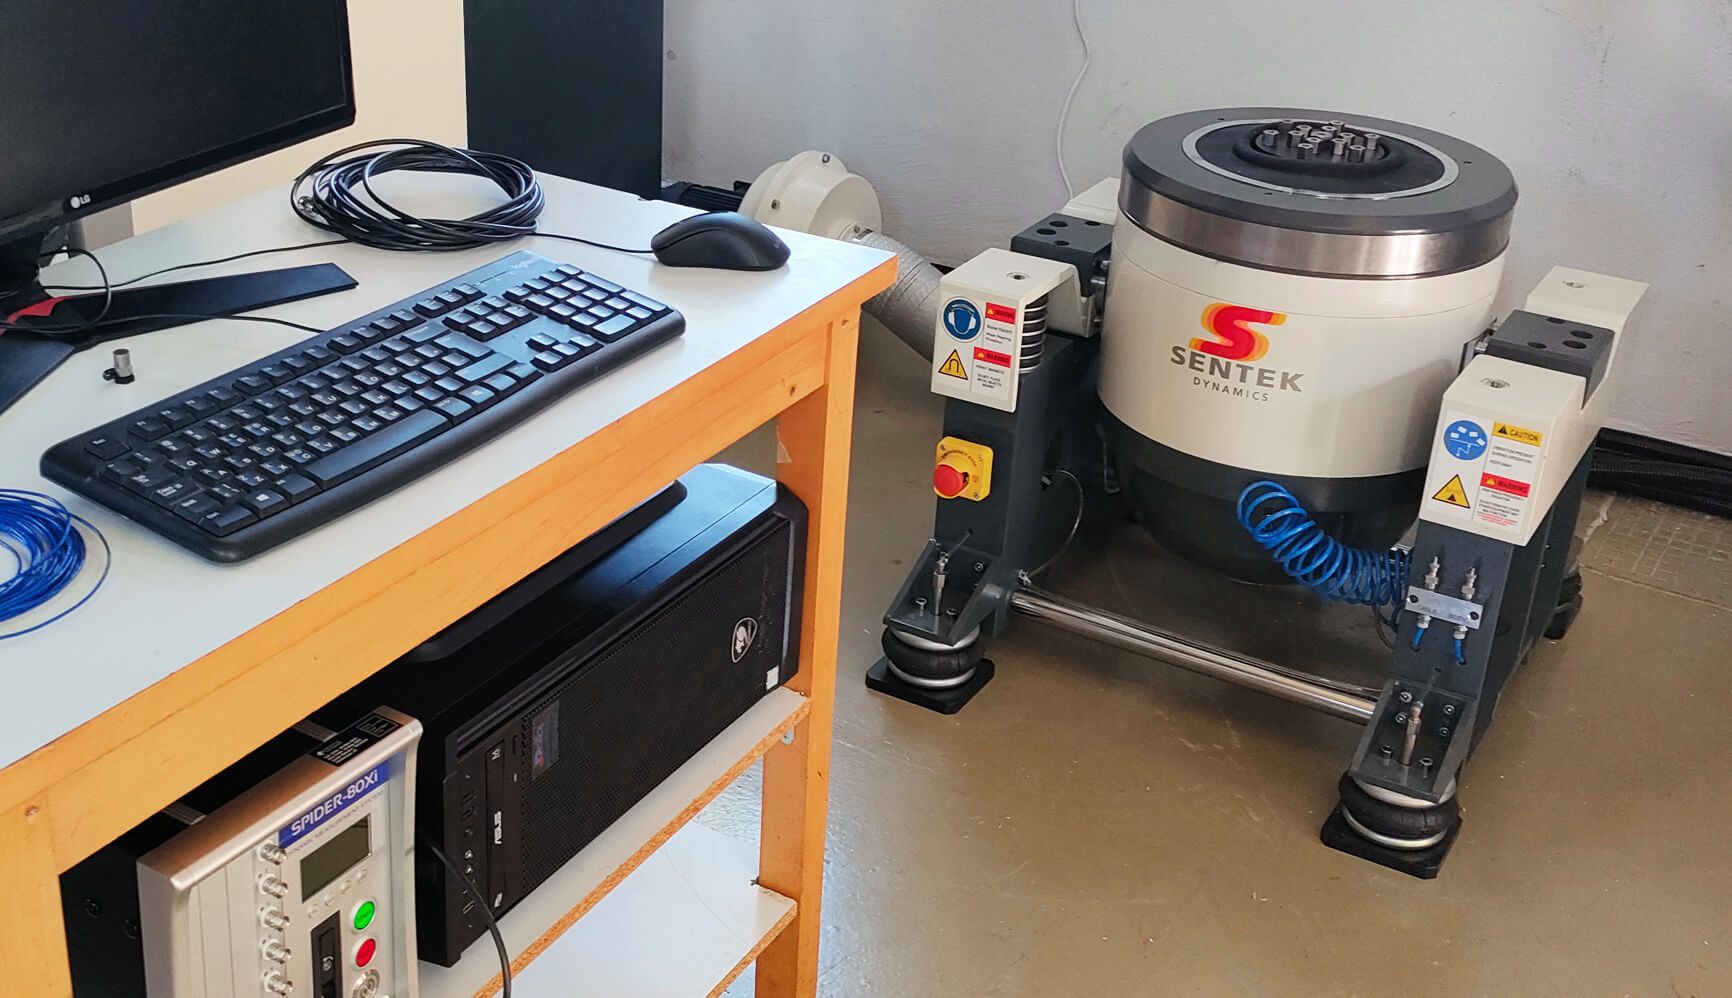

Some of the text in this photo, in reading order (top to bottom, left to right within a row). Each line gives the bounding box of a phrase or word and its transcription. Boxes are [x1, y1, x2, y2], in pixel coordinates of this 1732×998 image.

[80, 194, 91, 204] LG
[1170, 345, 1305, 392] SENTEK
[1193, 376, 1269, 402] DYNAMICS
[1509, 428, 1539, 442] CAUTION
[1498, 480, 1528, 493] WARNING
[291, 769, 379, 837] SPIDER-80Xi
[494, 811, 502, 845] ASUS
